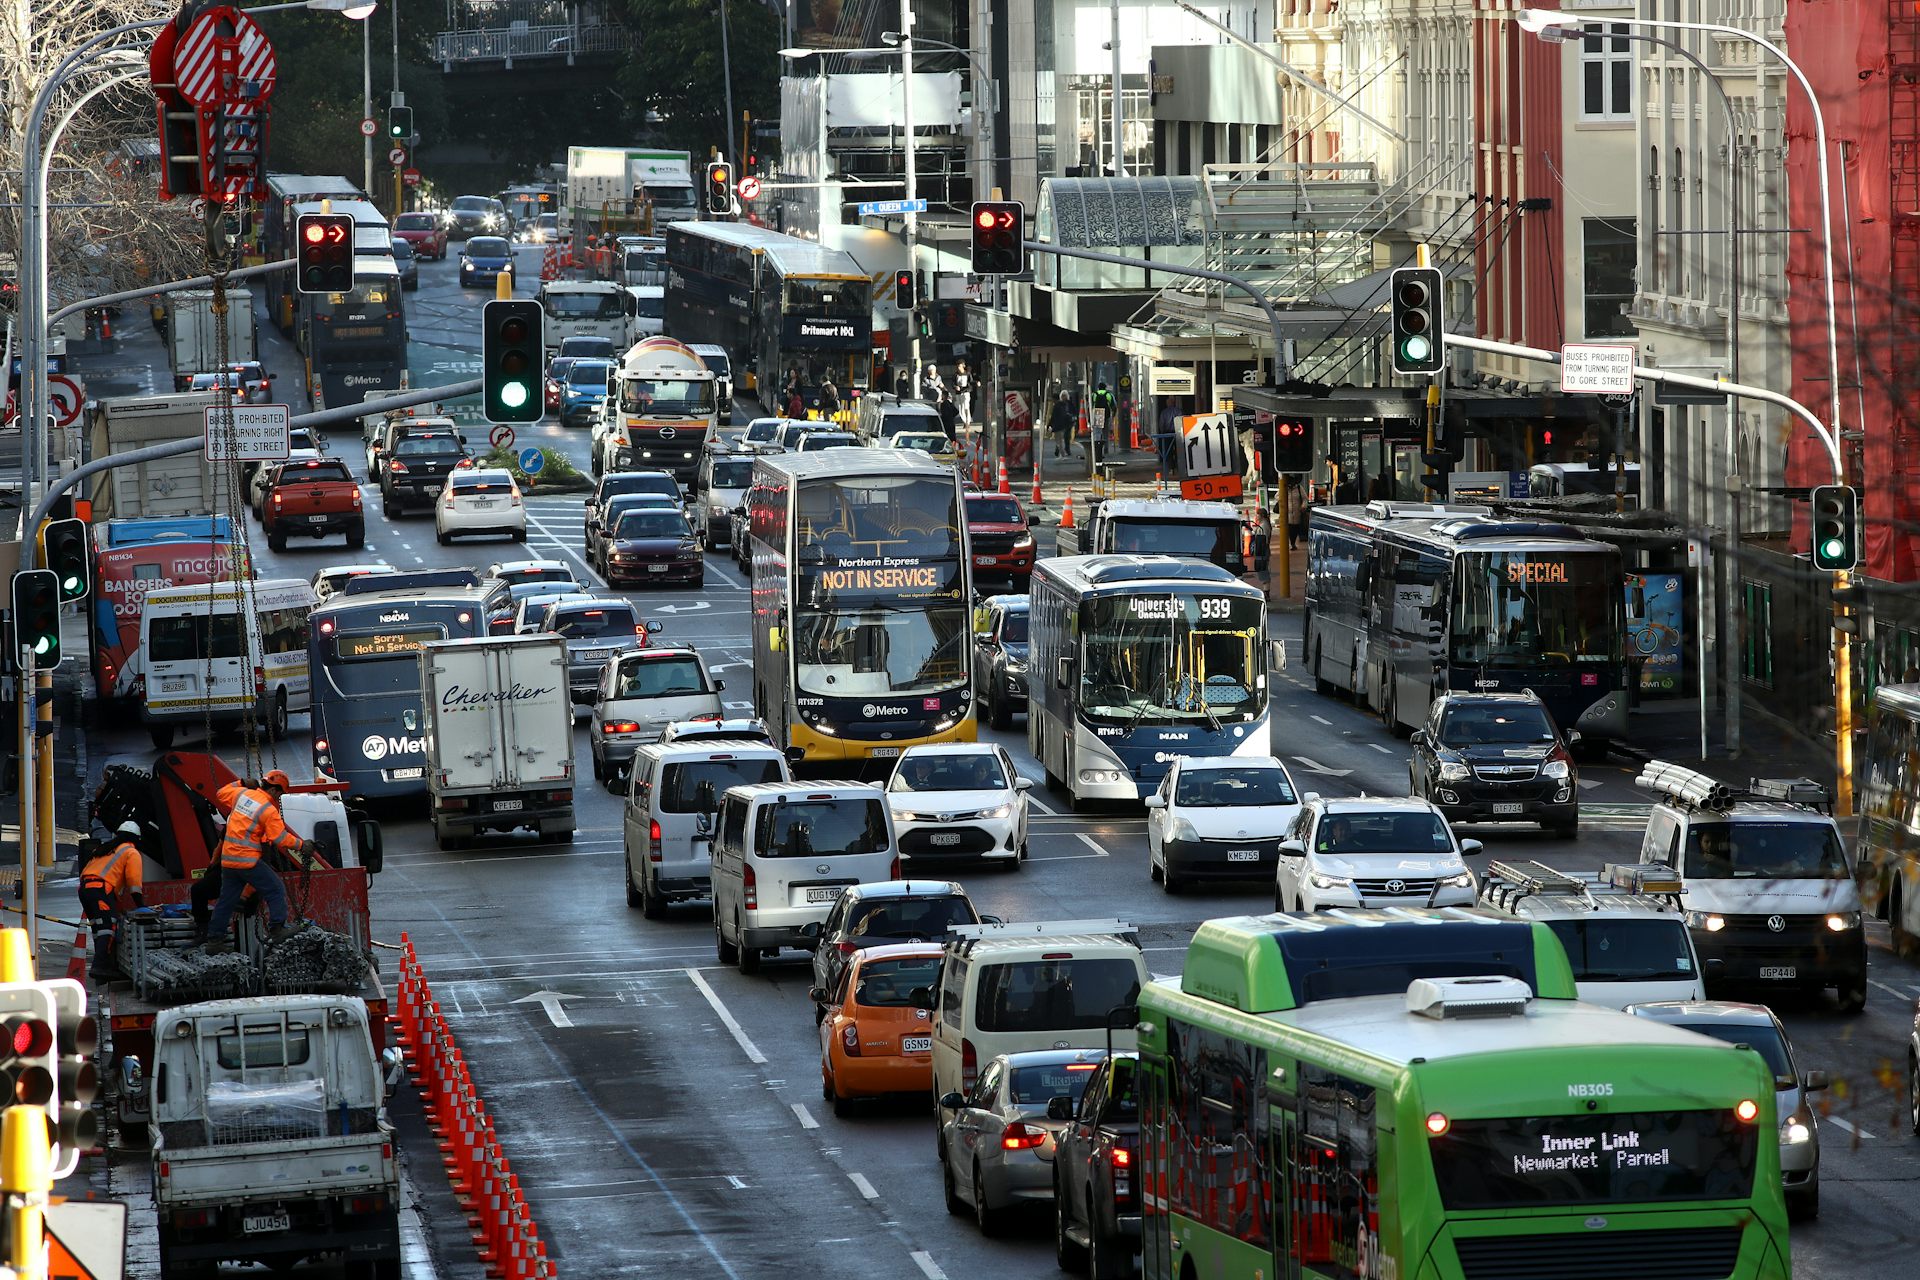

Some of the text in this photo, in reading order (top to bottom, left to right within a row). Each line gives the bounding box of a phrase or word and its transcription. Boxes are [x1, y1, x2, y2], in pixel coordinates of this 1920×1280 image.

[879, 203, 901, 212] QUEEN
[1566, 352, 1630, 363] BUSES PROHIBITED
[1565, 363, 1629, 374] FROM TURNING RIGHT
[355, 375, 381, 385] Metro
[1566, 375, 1628, 386] TO GORE STREET
[239, 413, 284, 425] PROHIBITED
[232, 428, 262, 438] URNING
[263, 427, 284, 438] RIGHT
[253, 440, 285, 452] STREET
[1194, 482, 1229, 496] 50 m
[838, 556, 919, 568] Northern Express
[823, 567, 937, 590] NOT IN SERVICE
[1508, 562, 1569, 583] SPECIAL
[104, 577, 173, 593] BANGERS
[124, 591, 144, 604] FO
[155, 594, 192, 604] DOCUMENT
[1130, 598, 1231, 619] University 939
[379, 614, 409, 623] NB4044
[373, 634, 404, 646] Sorry
[354, 641, 427, 655] Not in Servic
[1474, 679, 1500, 688] HE257
[442, 682, 557, 706] Chevalier
[160, 699, 197, 707] DOCUMENT
[797, 698, 824, 706] RT1372
[876, 705, 909, 716] Metro
[1097, 727, 1124, 736] RT1413
[390, 737, 427, 754] Met
[872, 748, 899, 757] LRG491
[493, 801, 522, 810] KPE132
[1494, 804, 1522, 813] GTF734
[807, 890, 841, 902] KUG190
[1760, 967, 1796, 978] JGP448
[1567, 1083, 1614, 1097] NB305
[1541, 1131, 1640, 1153] Inner Link
[1513, 1148, 1669, 1174] Newmarket Parnell
[245, 1216, 288, 1231] LJU454
